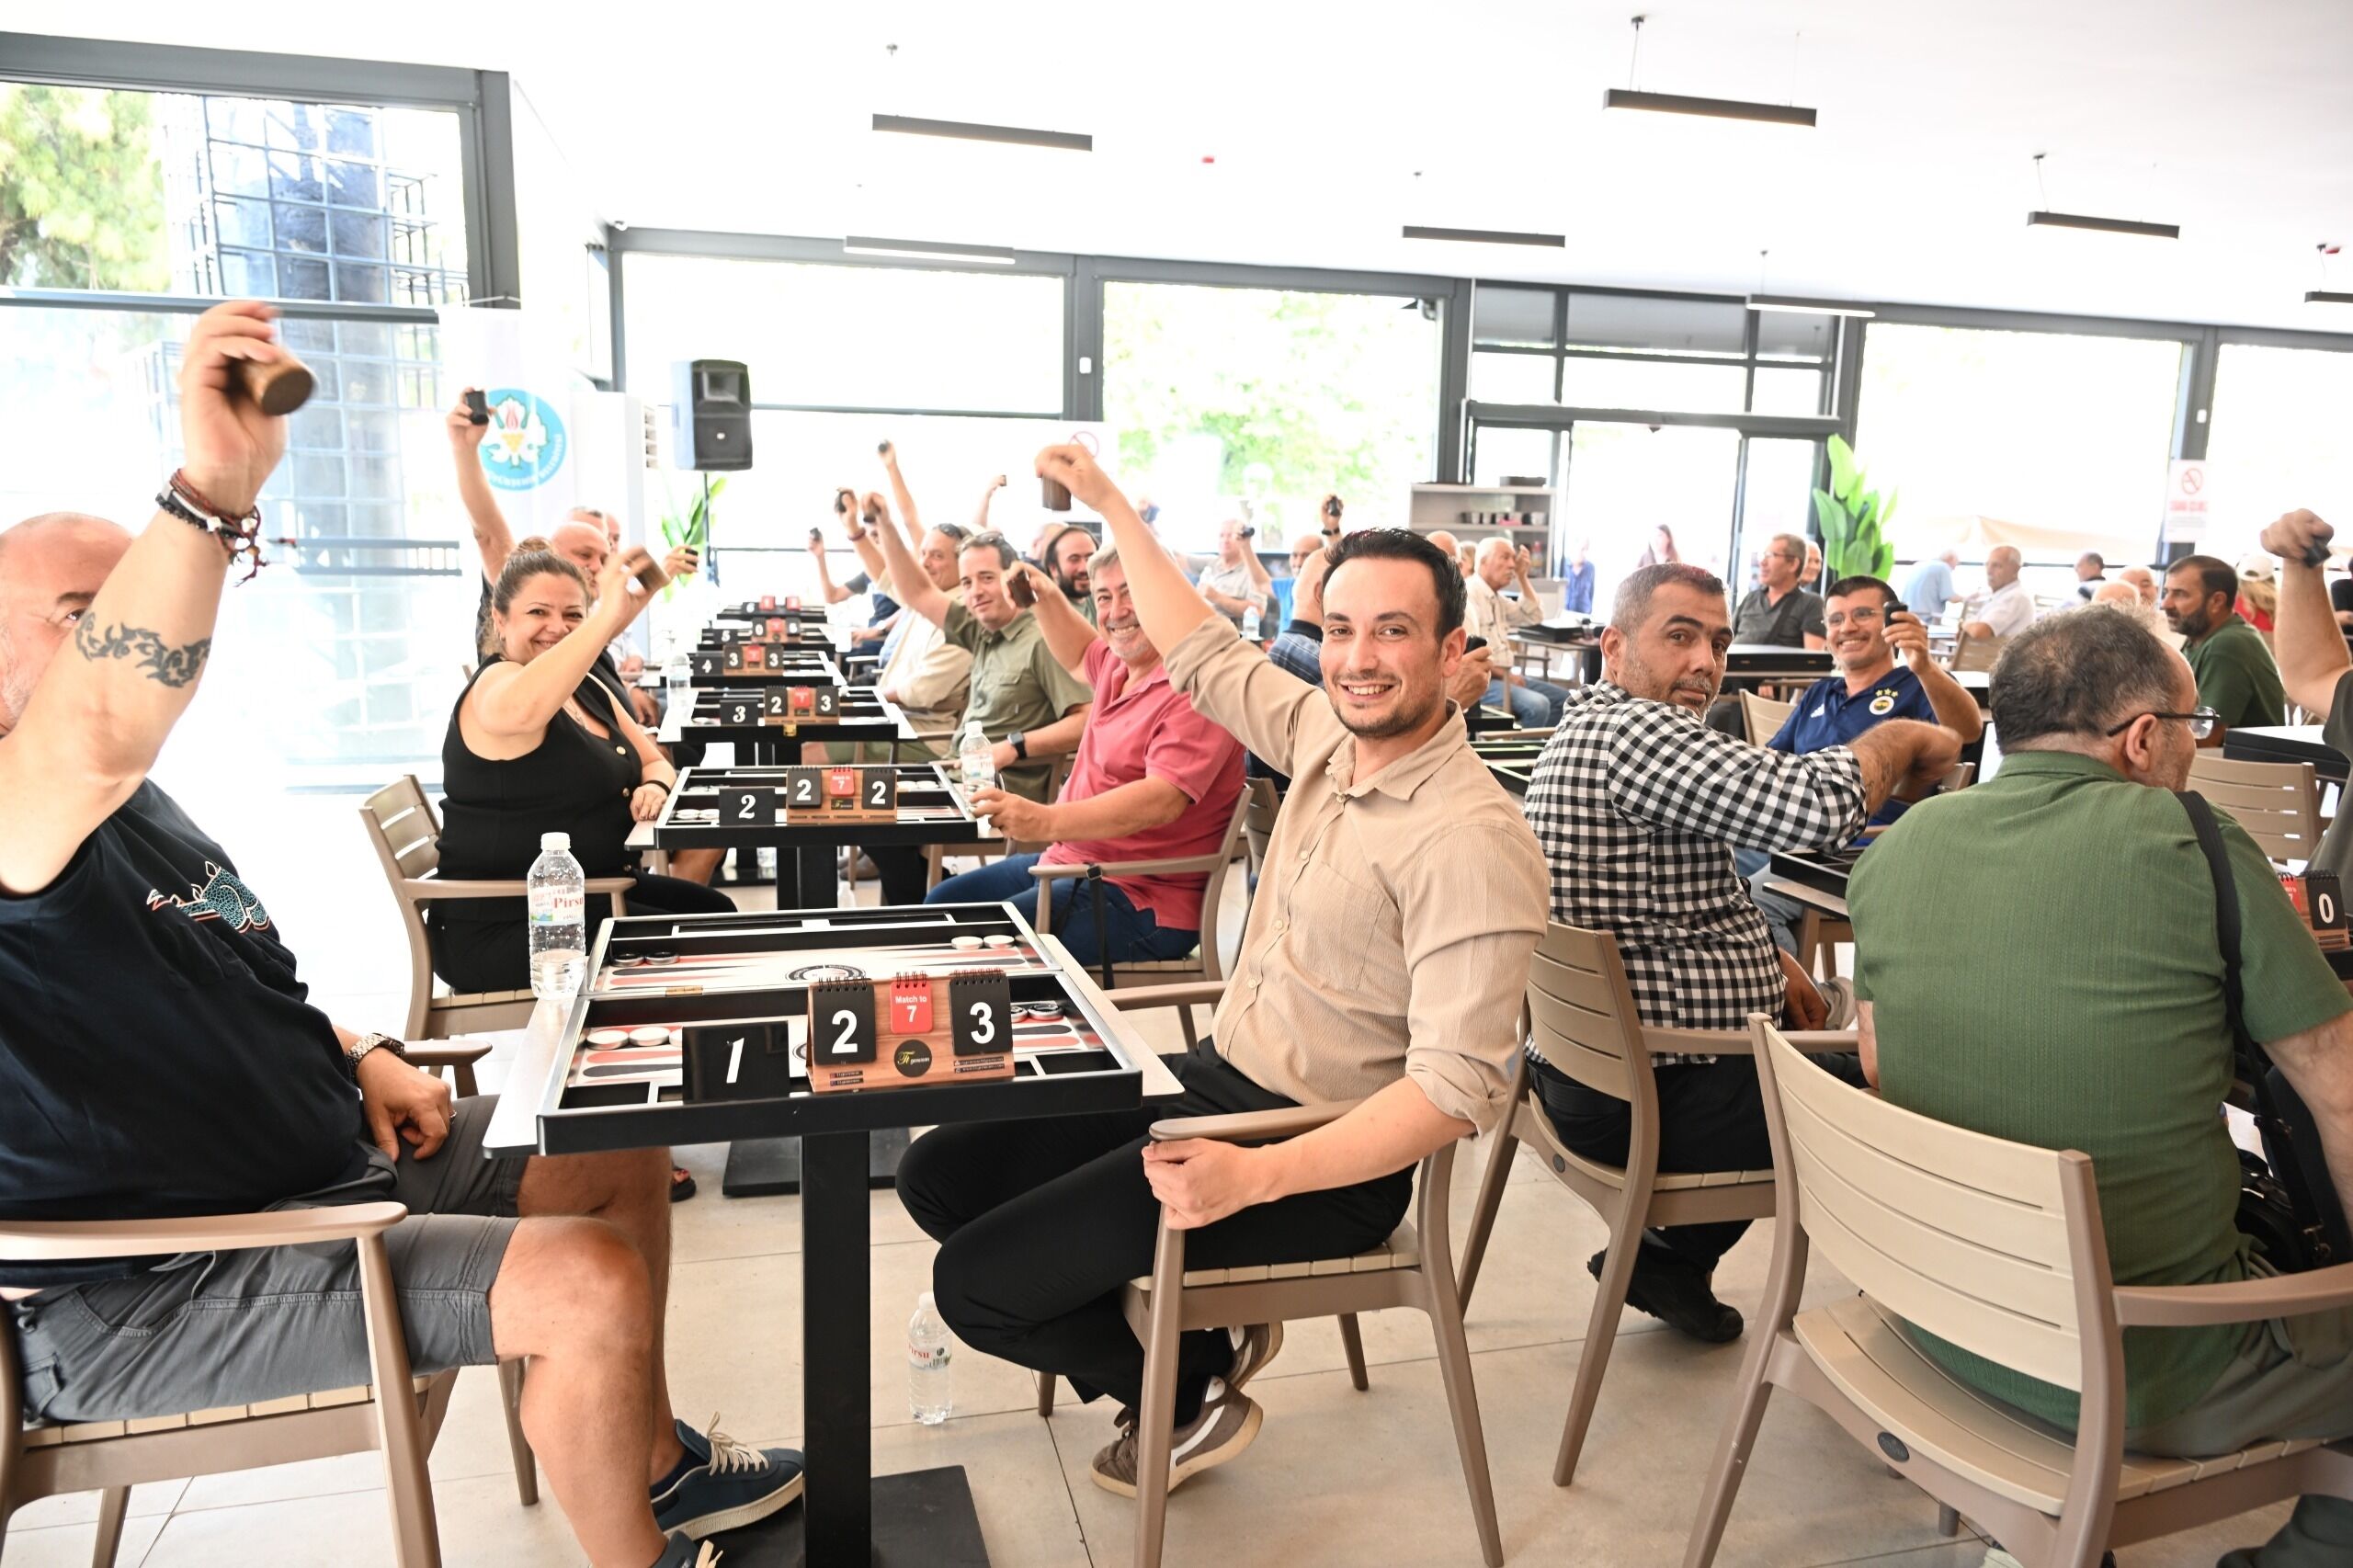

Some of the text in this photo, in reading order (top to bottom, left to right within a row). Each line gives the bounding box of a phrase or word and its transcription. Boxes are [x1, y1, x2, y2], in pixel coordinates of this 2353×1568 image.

[721, 630, 731, 642] 5
[701, 659, 712, 674] 4
[729, 652, 739, 667] 3
[769, 653, 779, 667] 3
[770, 696, 782, 713] 2
[820, 695, 832, 711] 3
[733, 705, 746, 722] 3
[796, 778, 812, 801] 2
[837, 779, 845, 790] 7
[870, 781, 886, 805] 2
[738, 794, 756, 819] 2
[2318, 892, 2335, 925] 0
[895, 995, 918, 1004] Match
[906, 1005, 917, 1023] 7
[831, 1009, 858, 1054] 2
[969, 1002, 995, 1044] 3
[726, 1038, 745, 1084] 1
